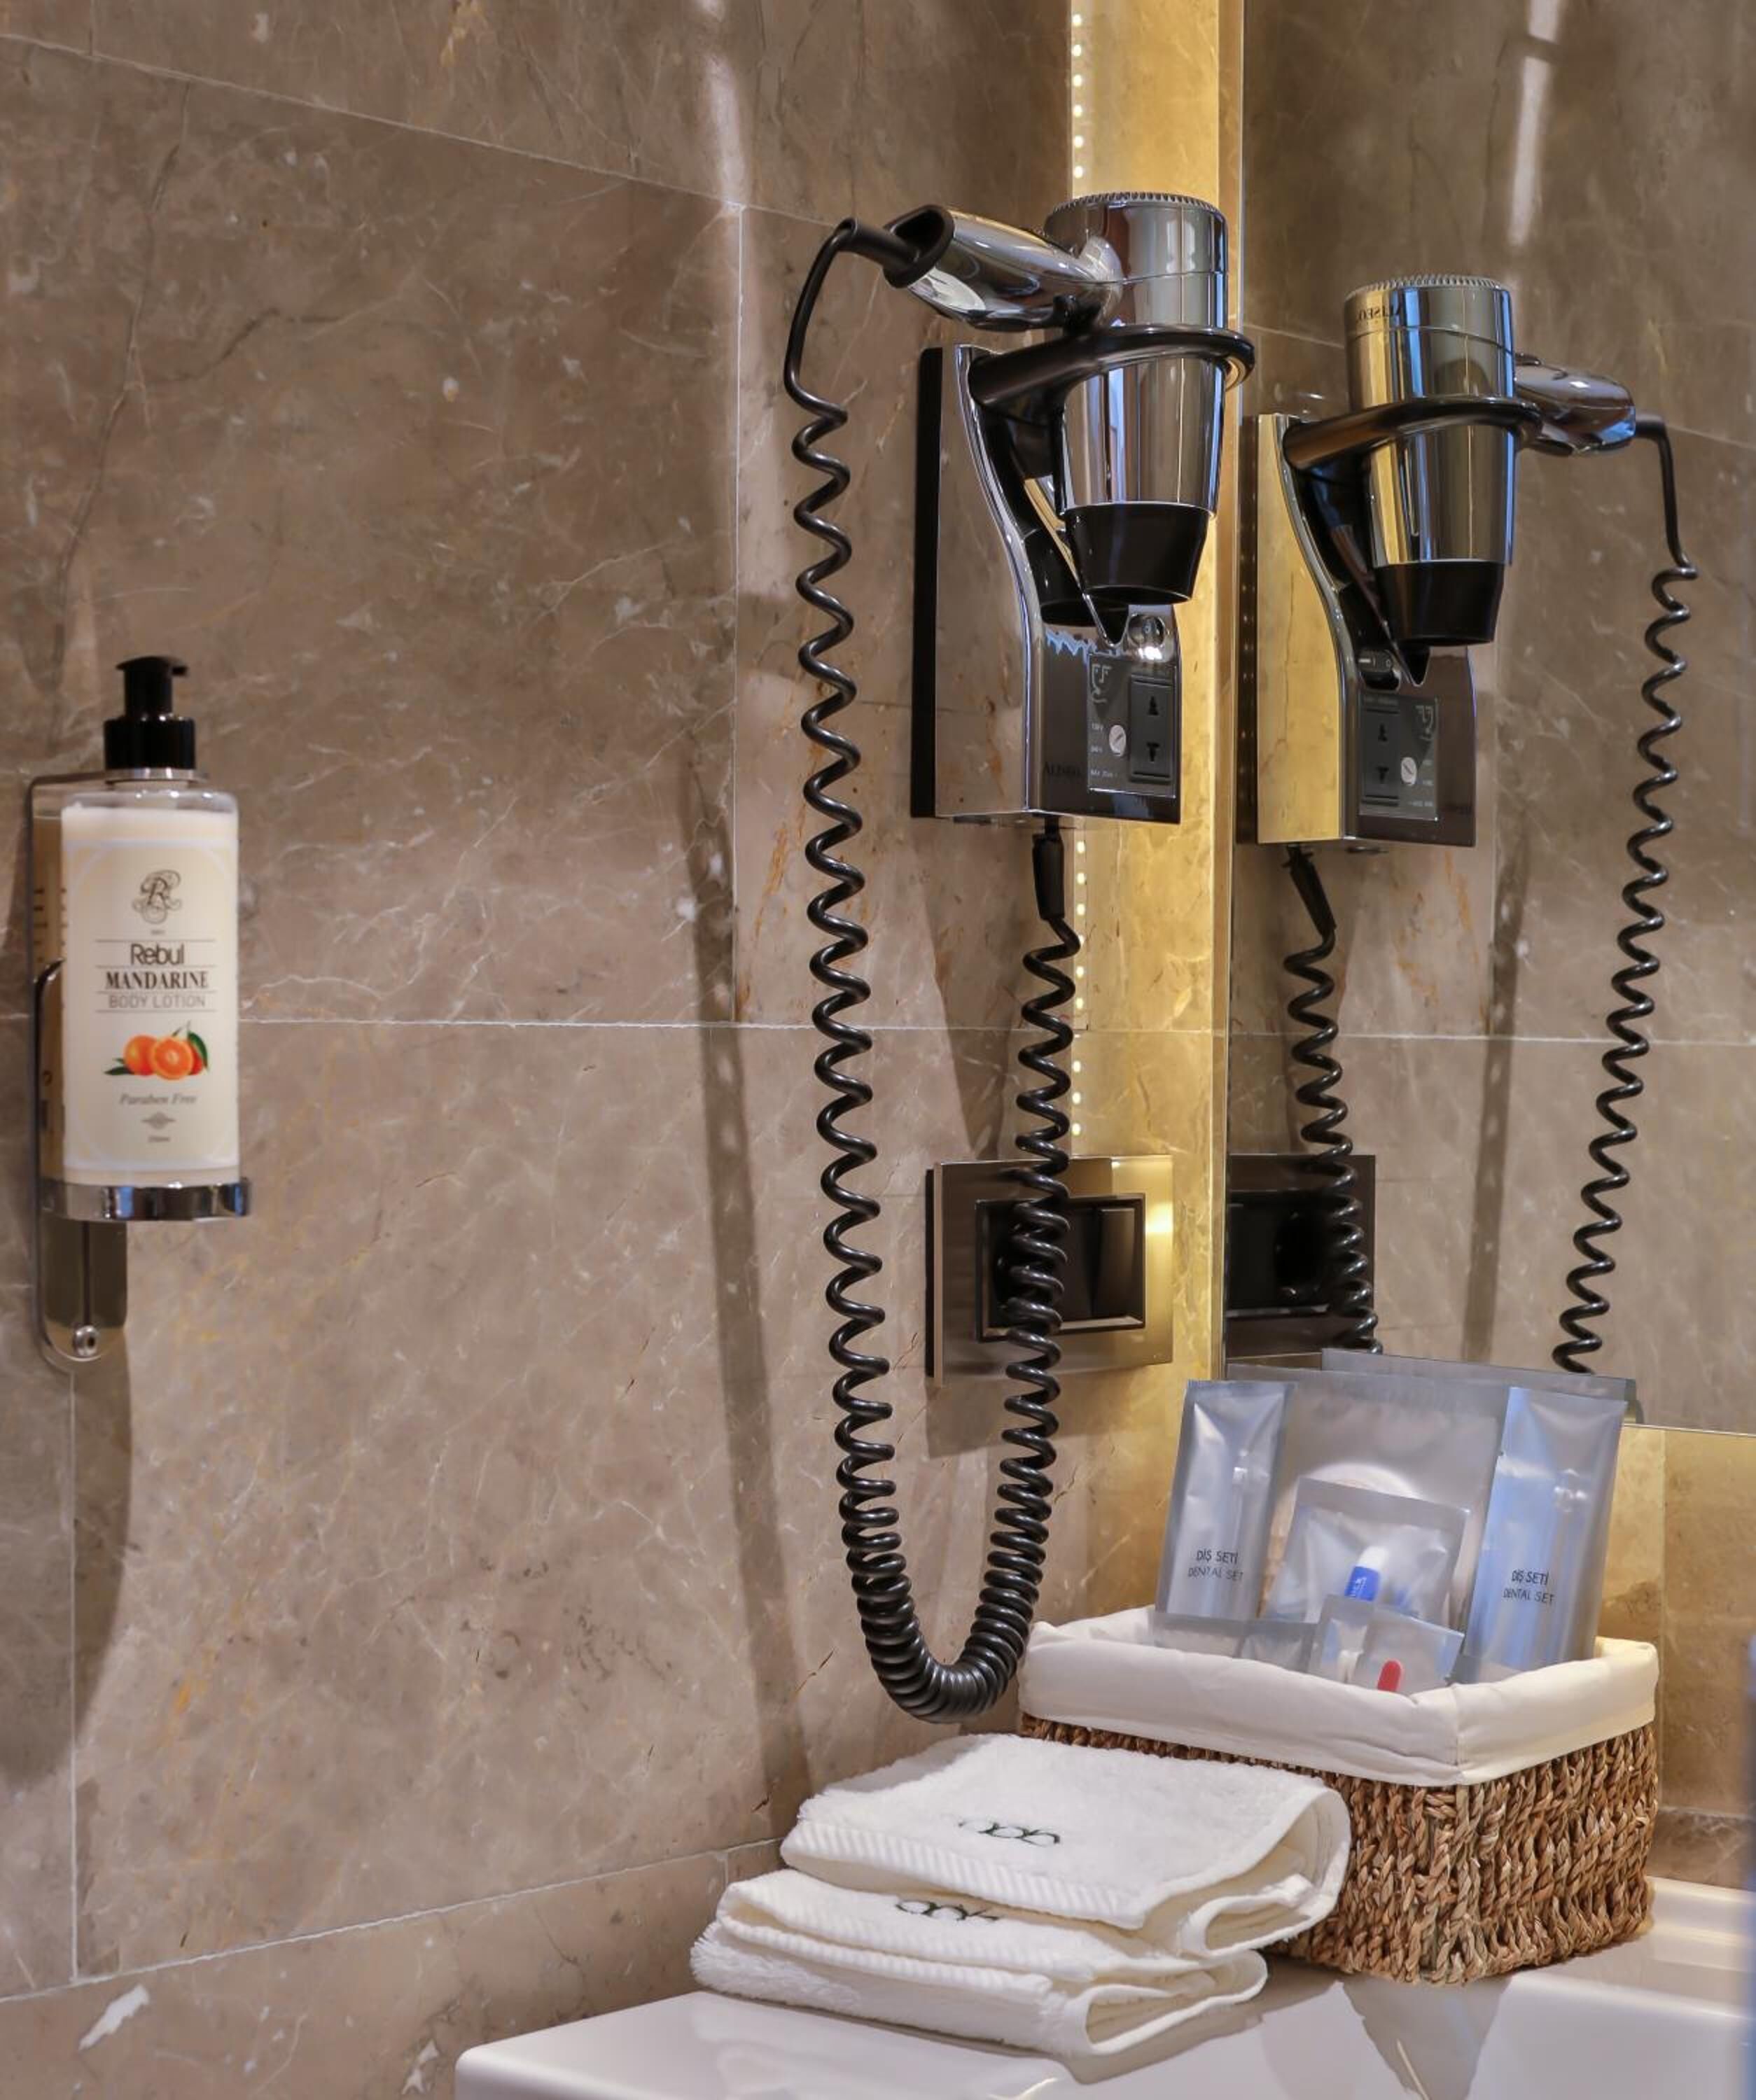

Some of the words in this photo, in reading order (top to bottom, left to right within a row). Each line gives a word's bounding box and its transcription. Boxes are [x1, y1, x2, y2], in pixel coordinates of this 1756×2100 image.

[130, 942, 185, 965] Rebul
[106, 970, 209, 989] MANDARINE
[109, 995, 147, 1009] BODY
[153, 994, 206, 1008] LOTION
[1187, 1566, 1222, 1578] DENTAL
[1225, 1569, 1243, 1581] SET
[1503, 1588, 1531, 1601] DENTAL
[1534, 1591, 1555, 1606] SET
